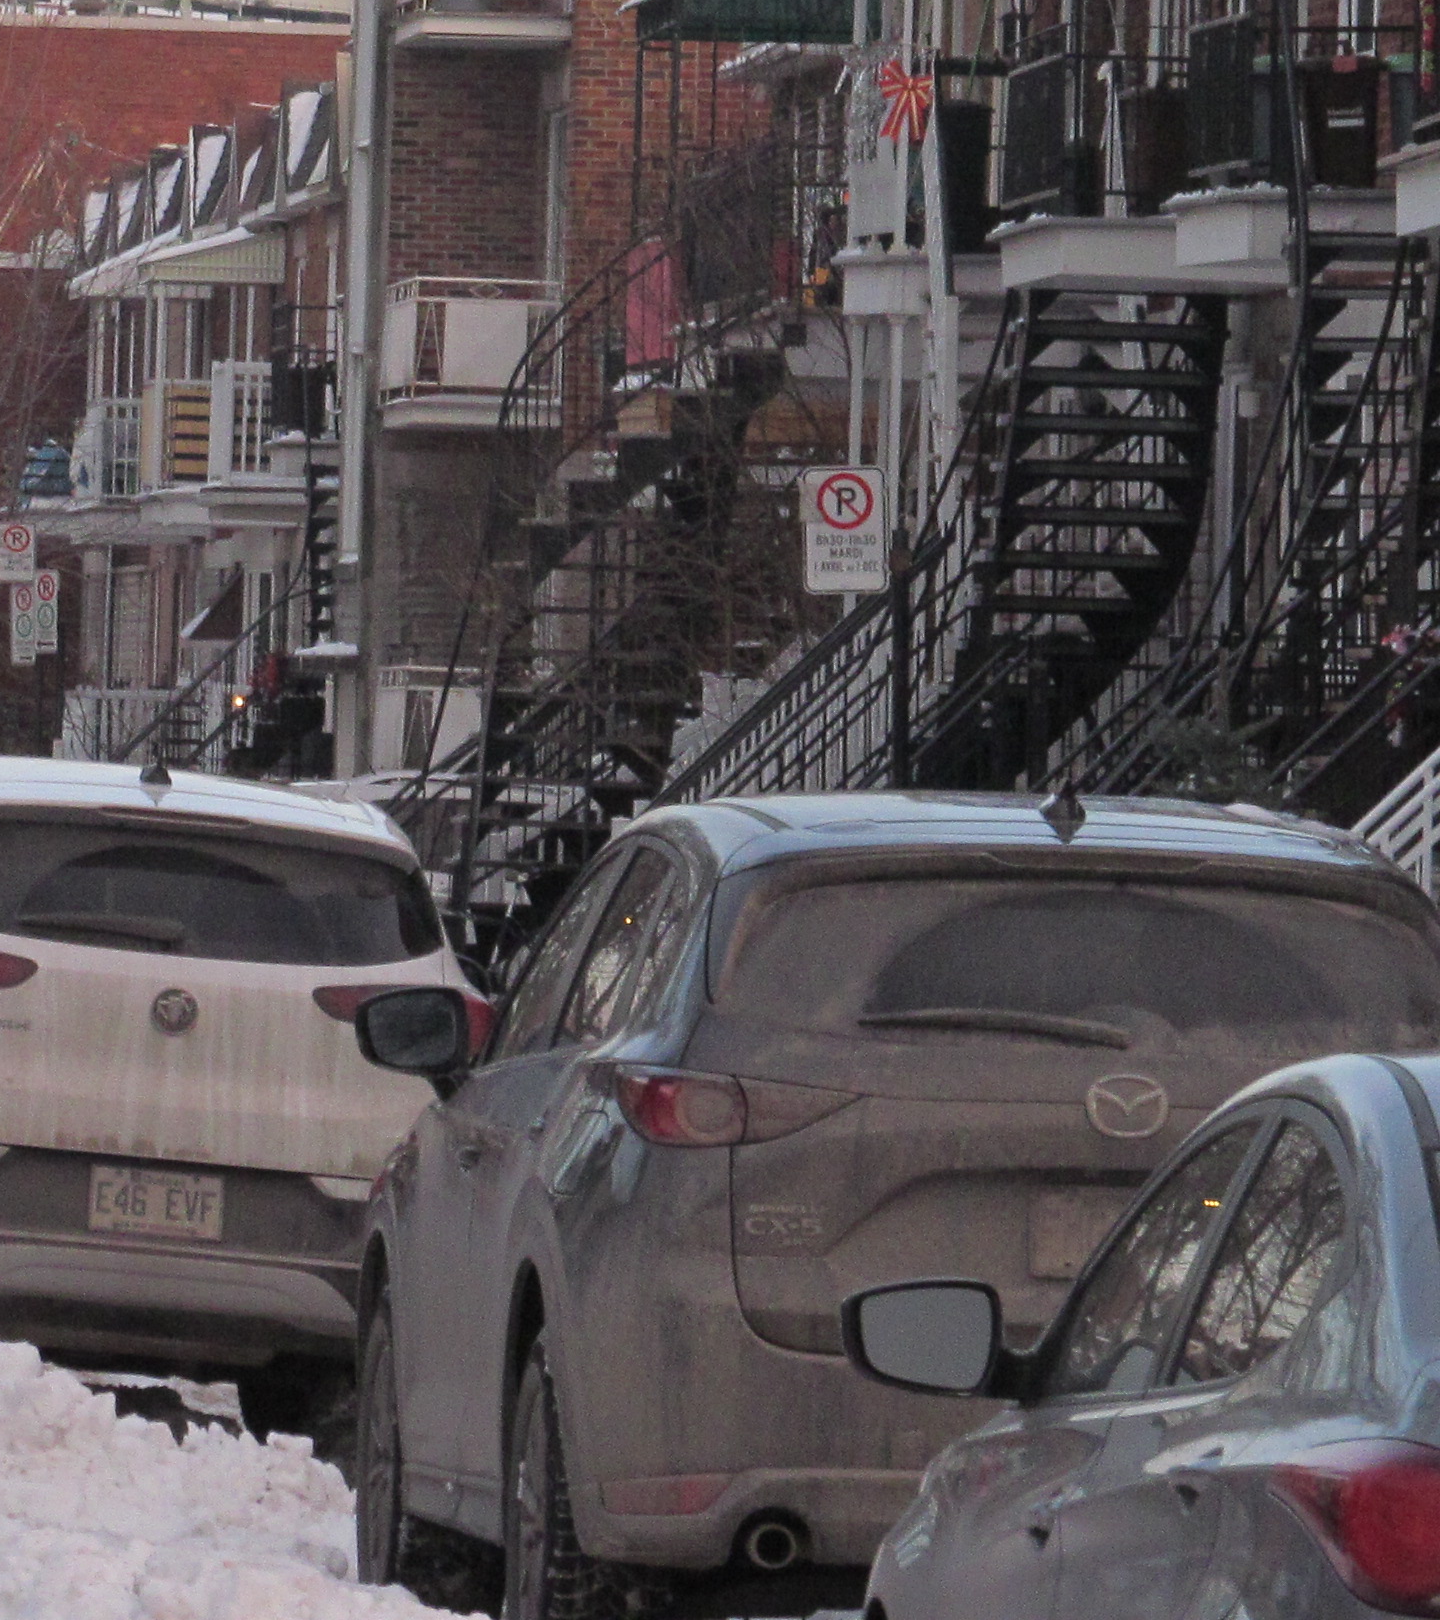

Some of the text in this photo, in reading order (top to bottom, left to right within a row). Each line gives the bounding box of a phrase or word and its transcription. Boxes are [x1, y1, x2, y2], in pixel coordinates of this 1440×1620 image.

[829, 547, 864, 559] MARDI
[96, 1182, 218, 1223] E46 EVF
[744, 1217, 824, 1235] CX-5
